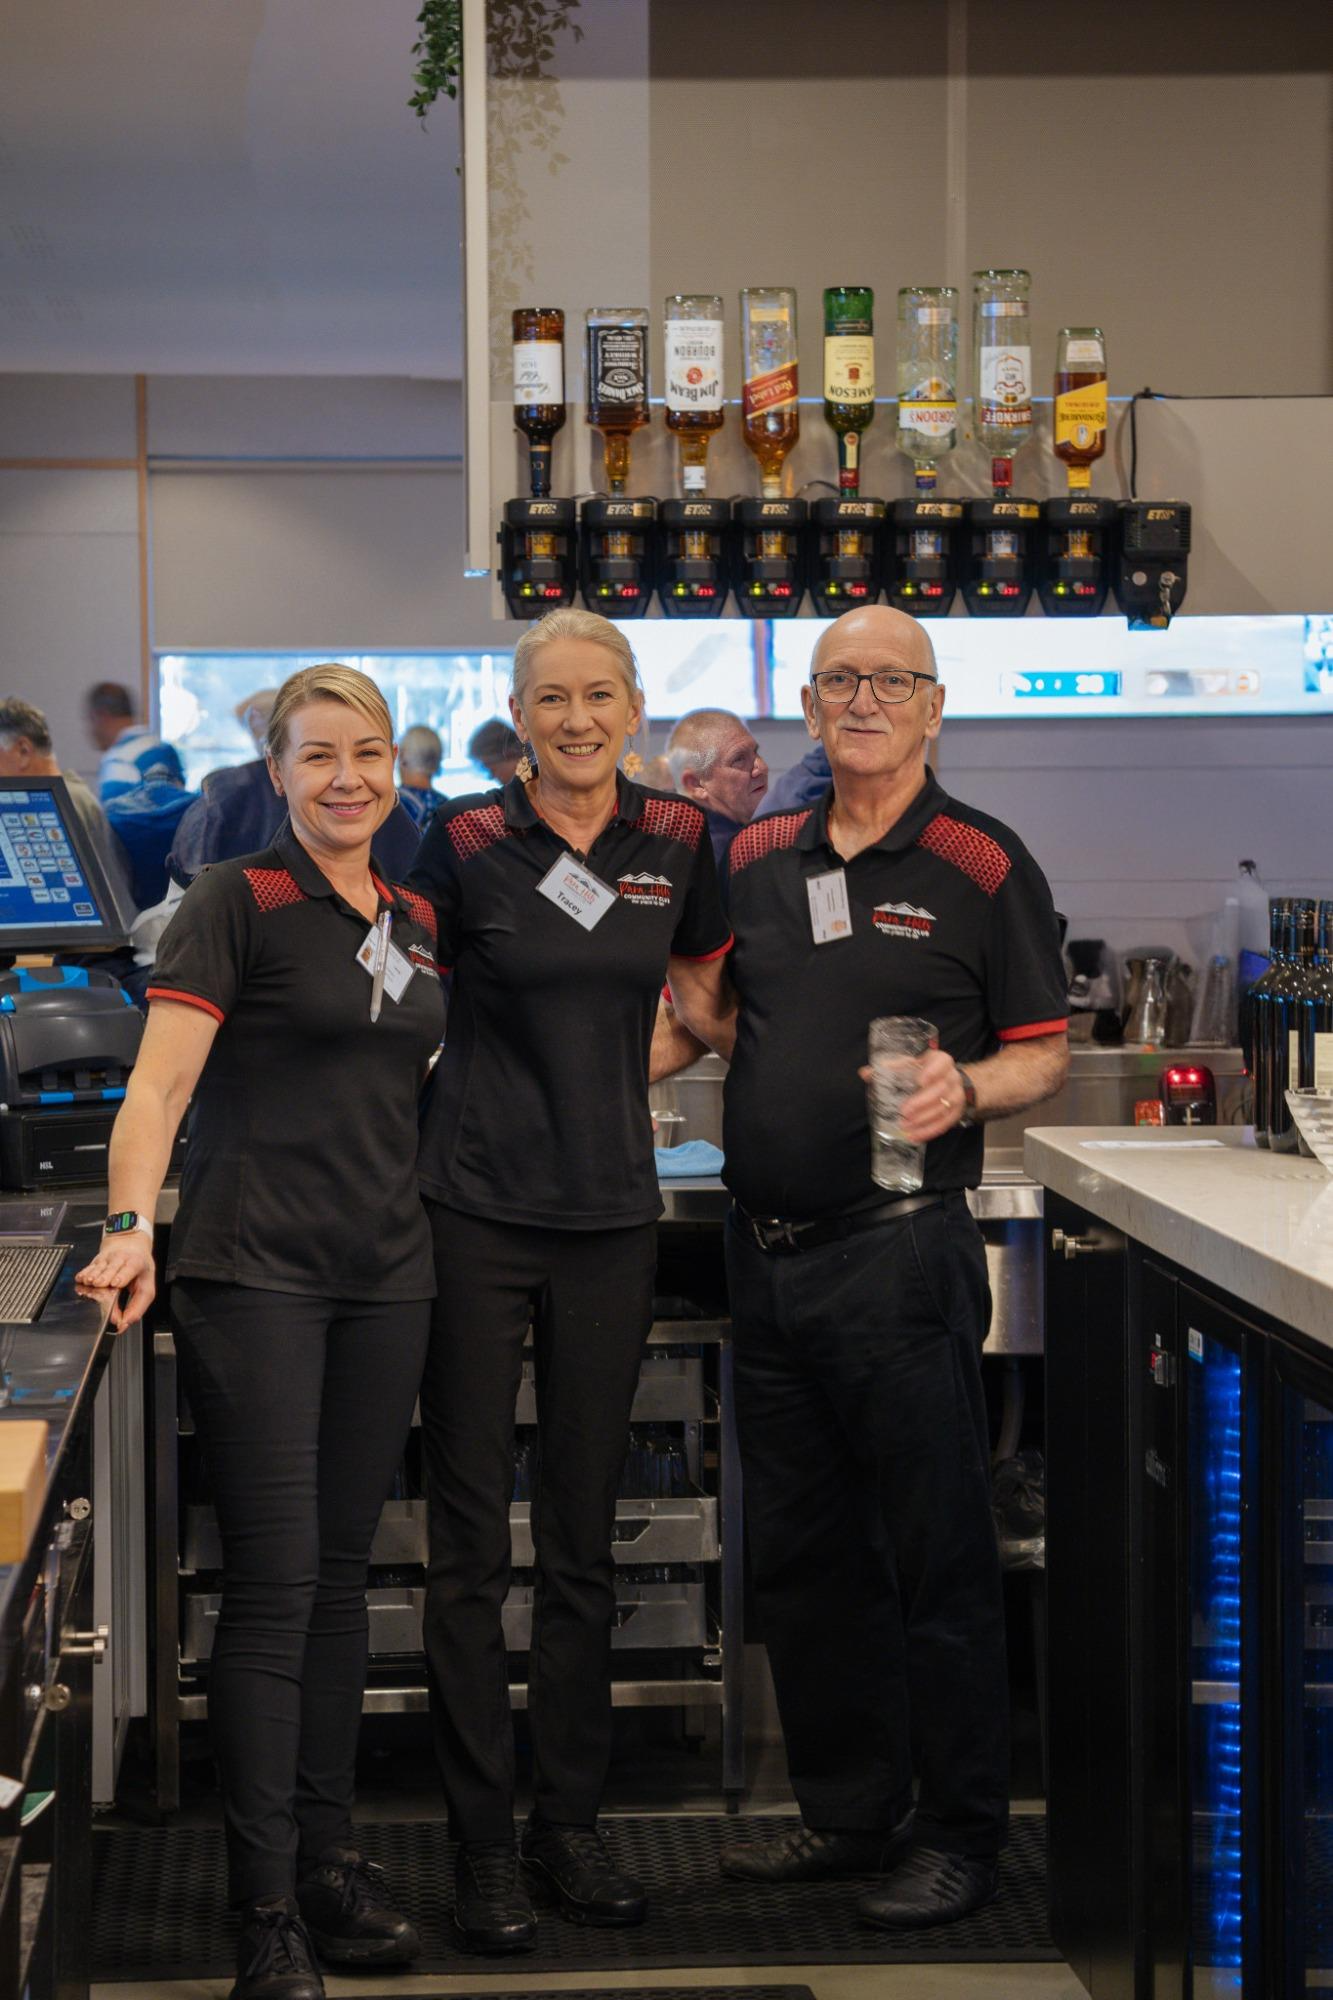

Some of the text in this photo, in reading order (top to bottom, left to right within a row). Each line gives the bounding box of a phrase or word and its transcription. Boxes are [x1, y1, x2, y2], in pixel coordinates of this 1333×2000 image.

[674, 346, 716, 356] BOURBON
[669, 380, 719, 402] JIM BEAM
[556, 890, 583, 915] Tracey
